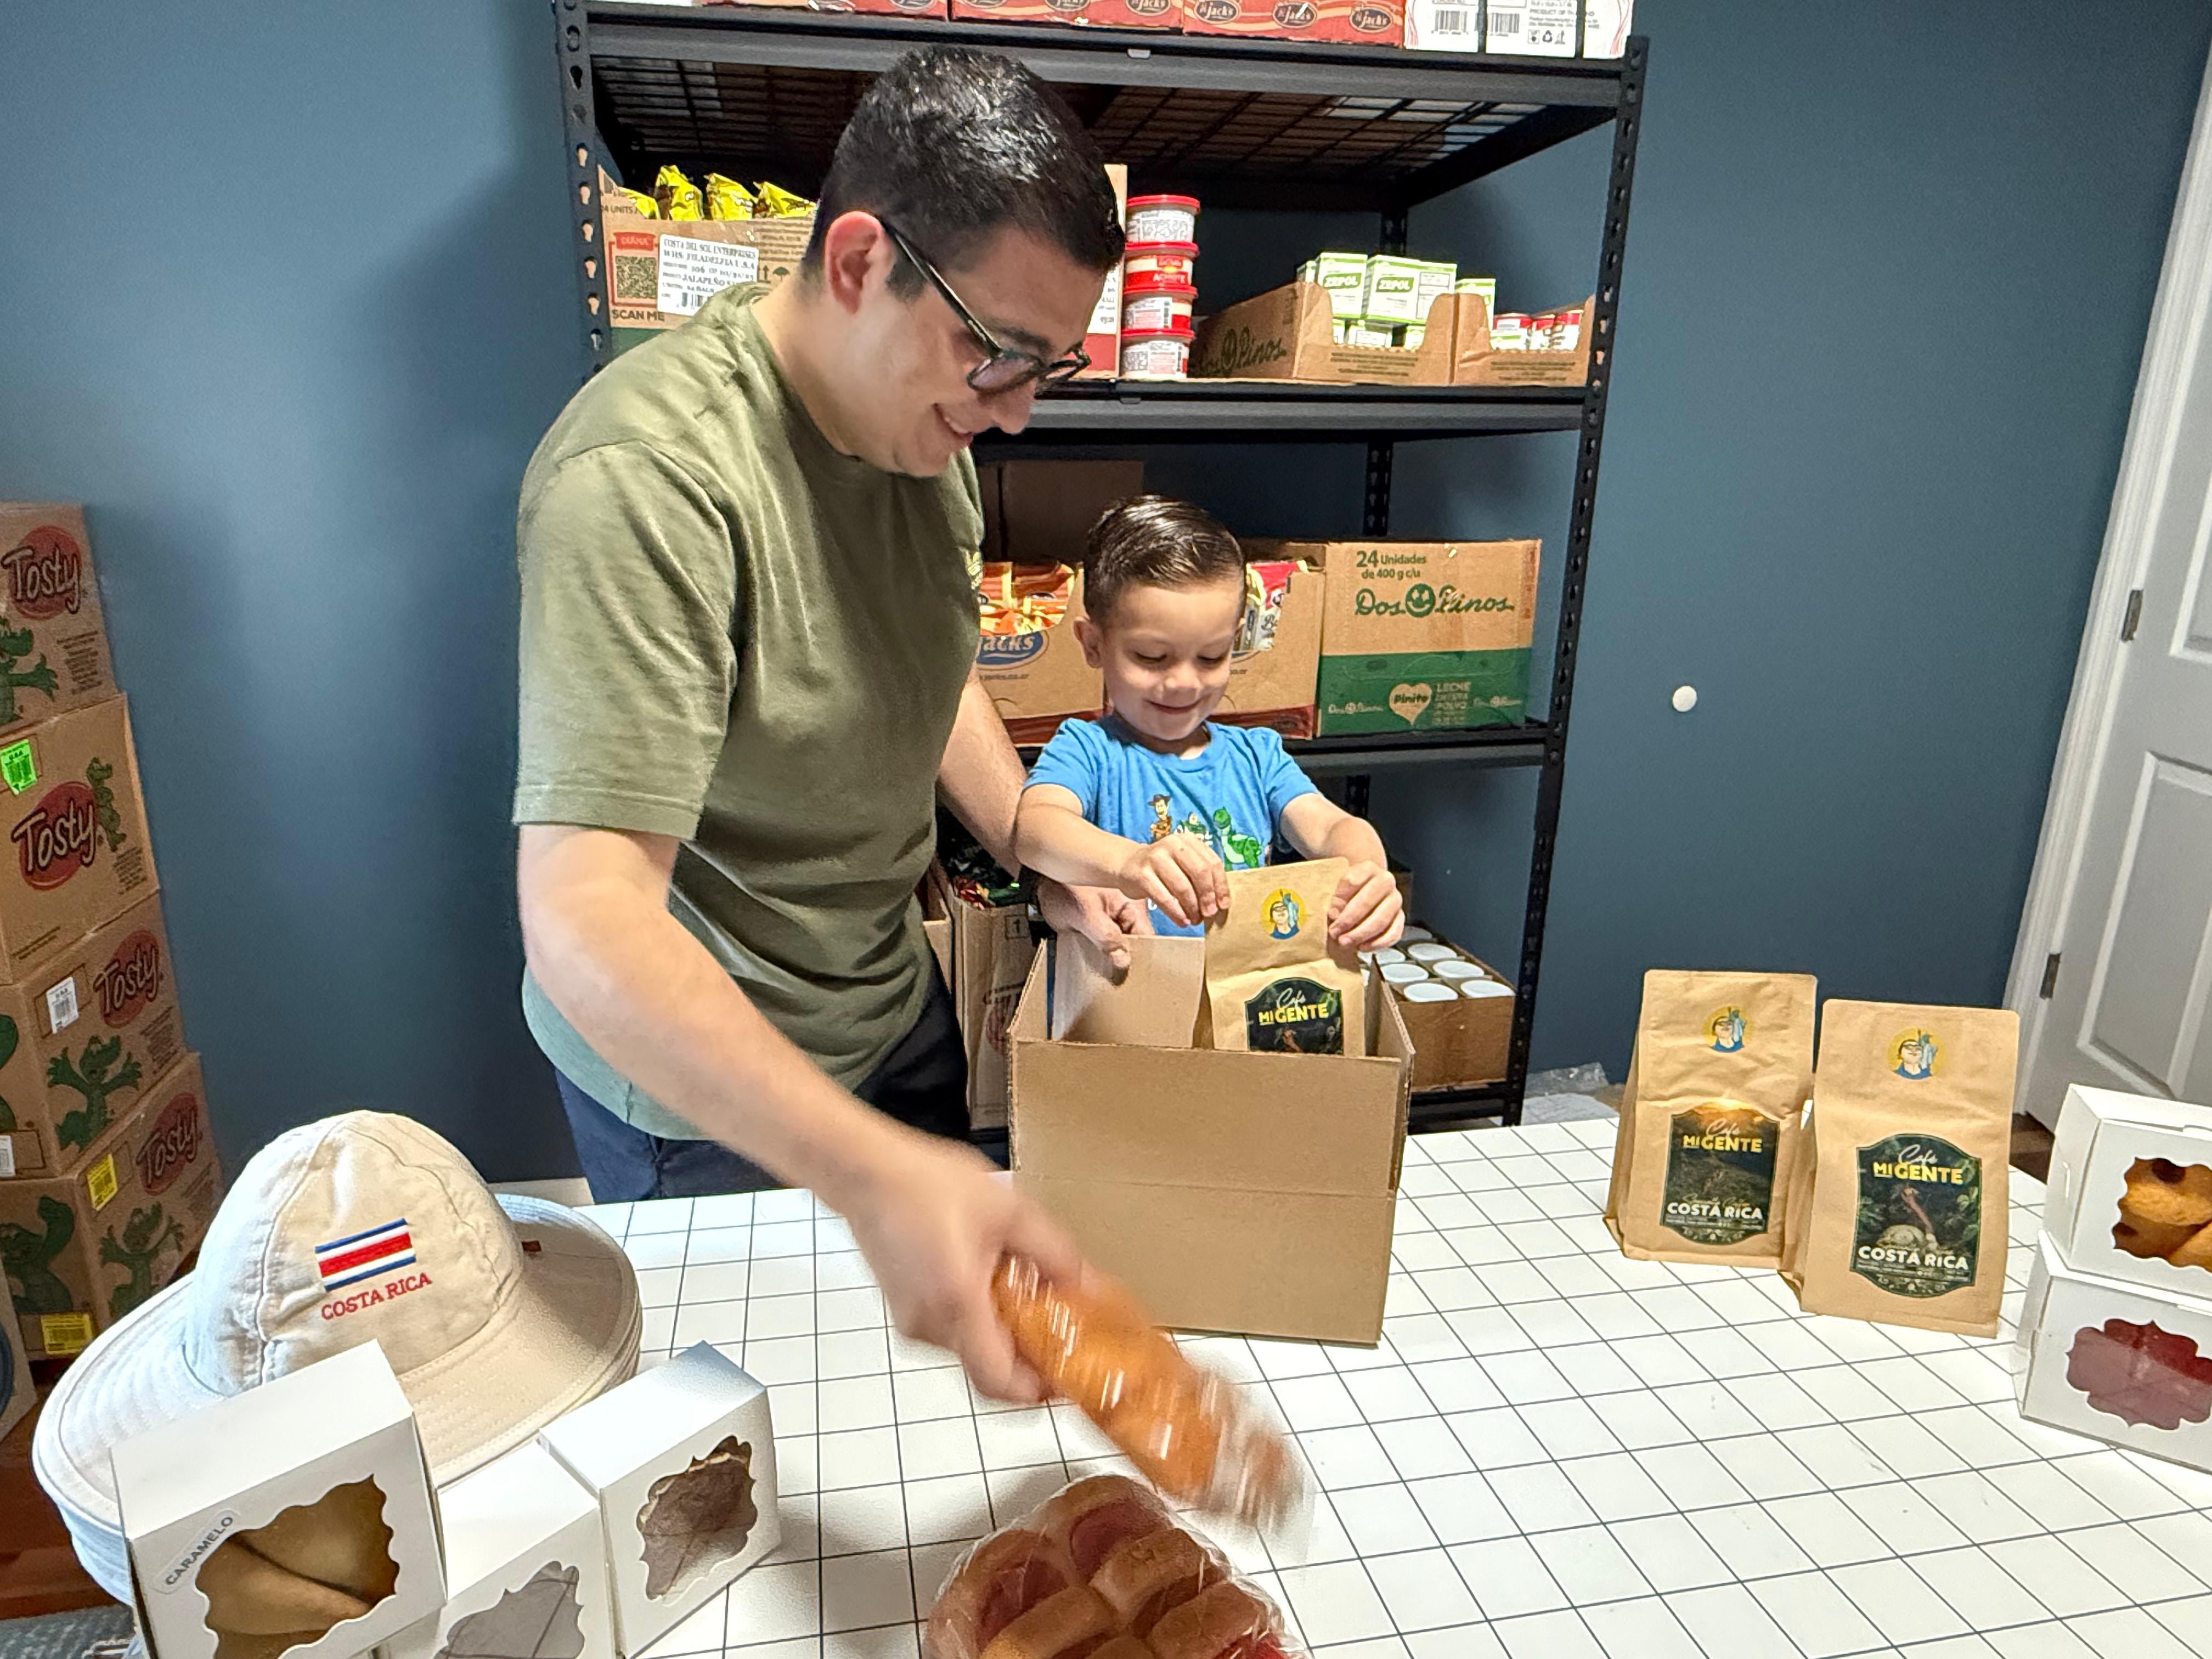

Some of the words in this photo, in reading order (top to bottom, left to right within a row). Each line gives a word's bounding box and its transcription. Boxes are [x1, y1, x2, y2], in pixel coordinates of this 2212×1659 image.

[1325, 276, 1358, 286] ZEPOL
[1379, 280, 1410, 290] ZEPOL
[612, 309, 645, 320] SCAN
[647, 310, 665, 321] ME
[1356, 550, 1378, 567] 24
[1380, 554, 1426, 565] Unidades
[1, 542, 81, 614] Tosty
[1361, 569, 1374, 579] de
[1376, 568, 1395, 578] 400
[1397, 570, 1403, 580] g
[1405, 567, 1421, 578] c/u
[1355, 588, 1406, 616] Dos
[1434, 584, 1515, 613] Pinos
[11, 797, 97, 875] Tosty
[92, 943, 160, 1017] Tosty
[1259, 1011, 1273, 1024] MI
[1275, 1003, 1329, 1023] GENTE
[136, 1107, 198, 1189] Tosty
[1683, 1135, 1700, 1148] MI
[1701, 1136, 1762, 1153] GENTE
[1873, 1161, 1892, 1177] MI
[1894, 1164, 1963, 1185] GENTE
[1667, 1202, 1722, 1217] COSTA
[1724, 1206, 1763, 1220] RICA
[1859, 1245, 1921, 1265] COSTA
[1925, 1252, 1969, 1271] RICA
[321, 1289, 385, 1320] COSTA
[385, 1272, 433, 1300] RICA
[166, 1516, 233, 1585] CARAMELO
